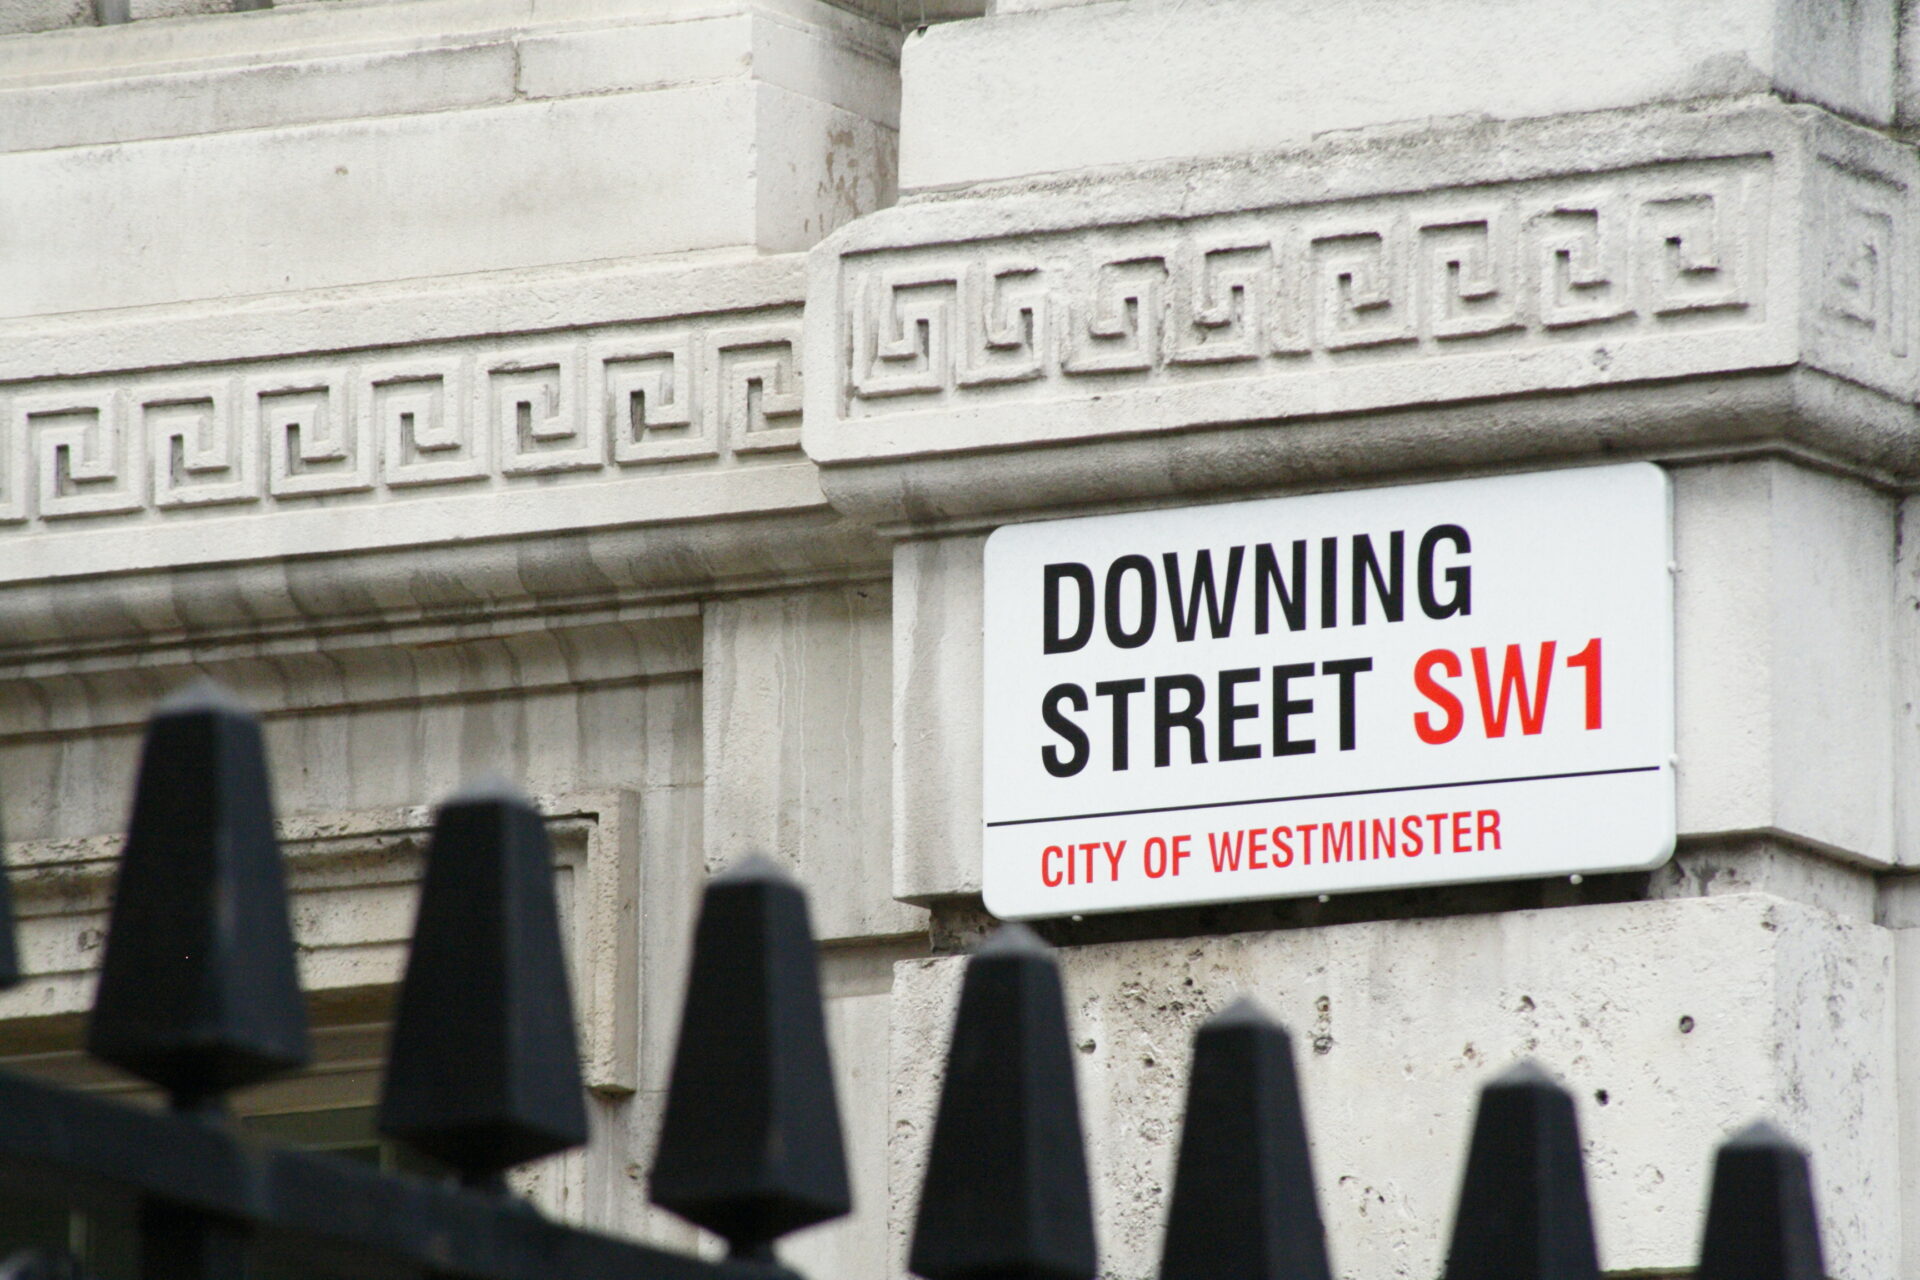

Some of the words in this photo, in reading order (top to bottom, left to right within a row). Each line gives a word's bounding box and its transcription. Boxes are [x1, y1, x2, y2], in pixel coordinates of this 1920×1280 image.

[1043, 524, 1472, 655] DOWNING
[1041, 657, 1373, 778] STREET
[1413, 637, 1603, 745] SW1
[1041, 840, 1127, 888] CITY
[1143, 835, 1192, 879] OF
[1208, 809, 1502, 873] WESTMINSTER
